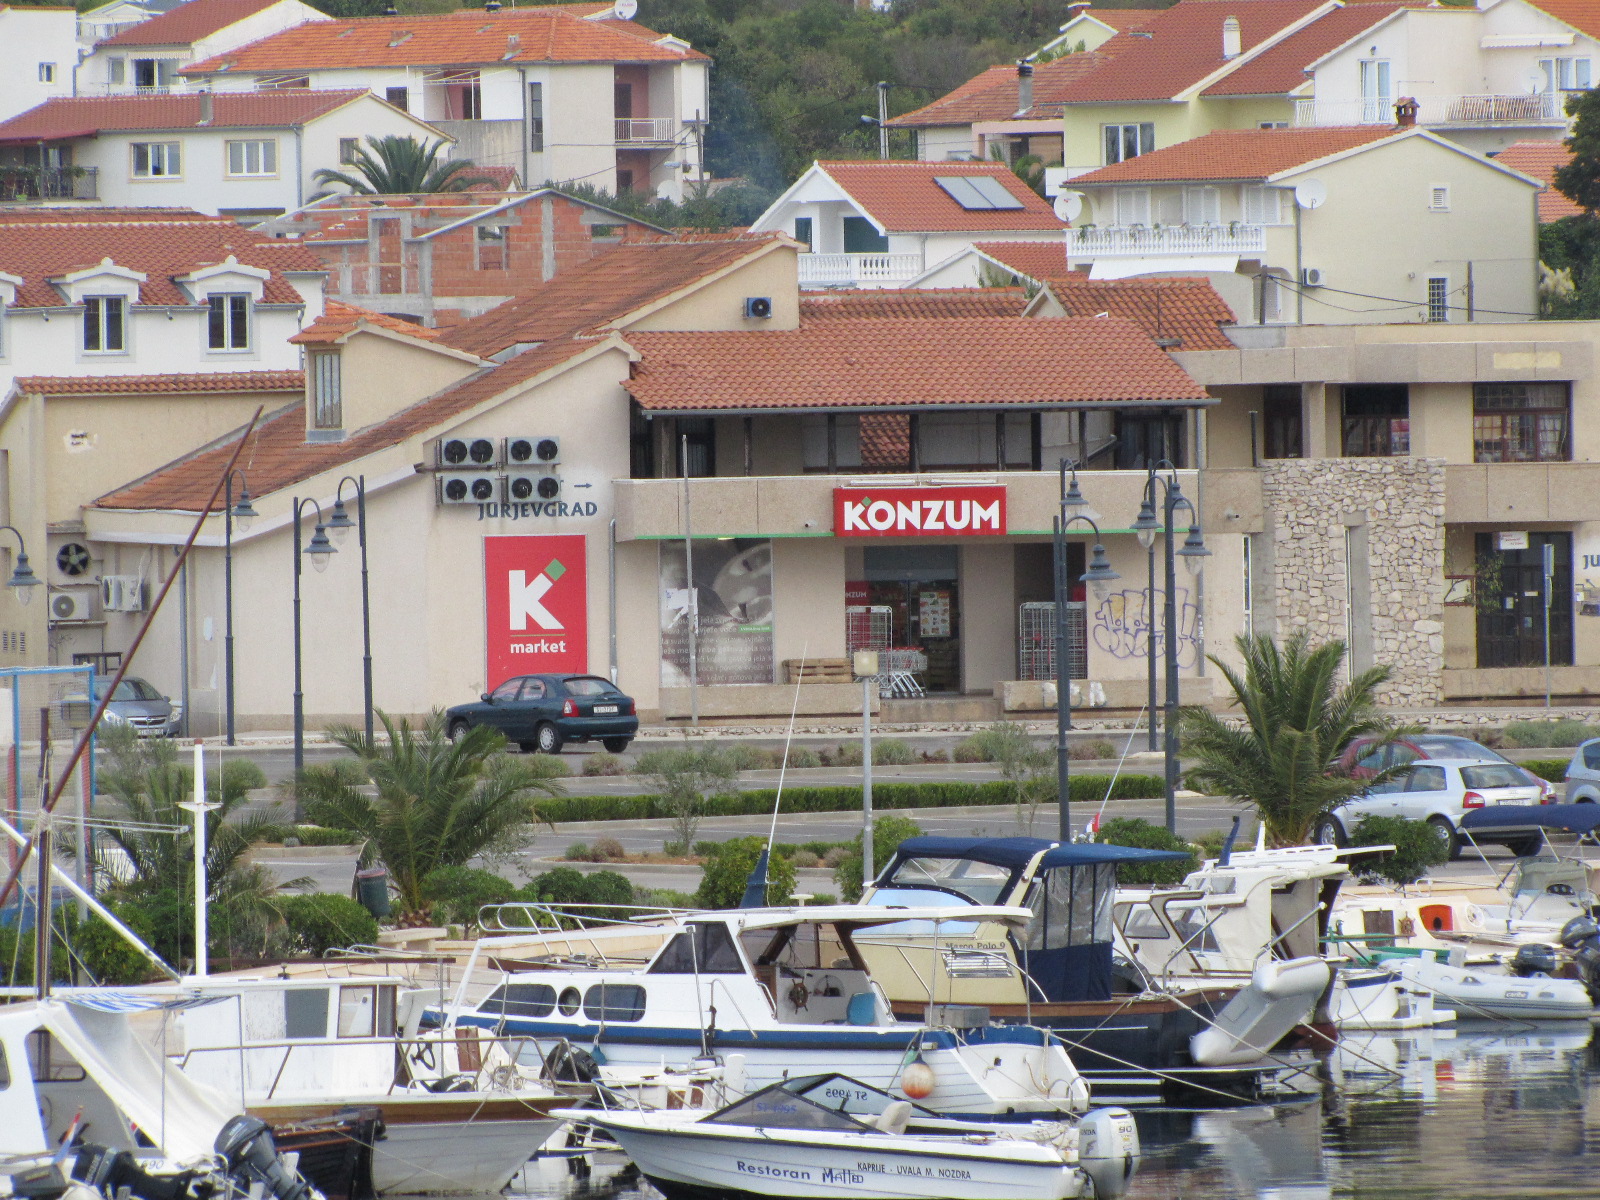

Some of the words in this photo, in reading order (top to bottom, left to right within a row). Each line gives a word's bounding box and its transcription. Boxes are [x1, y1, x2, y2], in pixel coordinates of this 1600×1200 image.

[477, 501, 598, 521] JURJEVGRAD
[844, 500, 1000, 531] KONZUM
[509, 559, 566, 630] K
[846, 591, 867, 599] NZUM
[510, 639, 566, 654] market
[977, 942, 997, 950] Polo
[1118, 1125, 1133, 1134] 90
[736, 1160, 811, 1180] Restoran
[857, 1162, 886, 1174] KAPRIJE
[896, 1164, 922, 1177] UVALA
[925, 1167, 935, 1177] M.
[938, 1168, 971, 1180] NOZDRA
